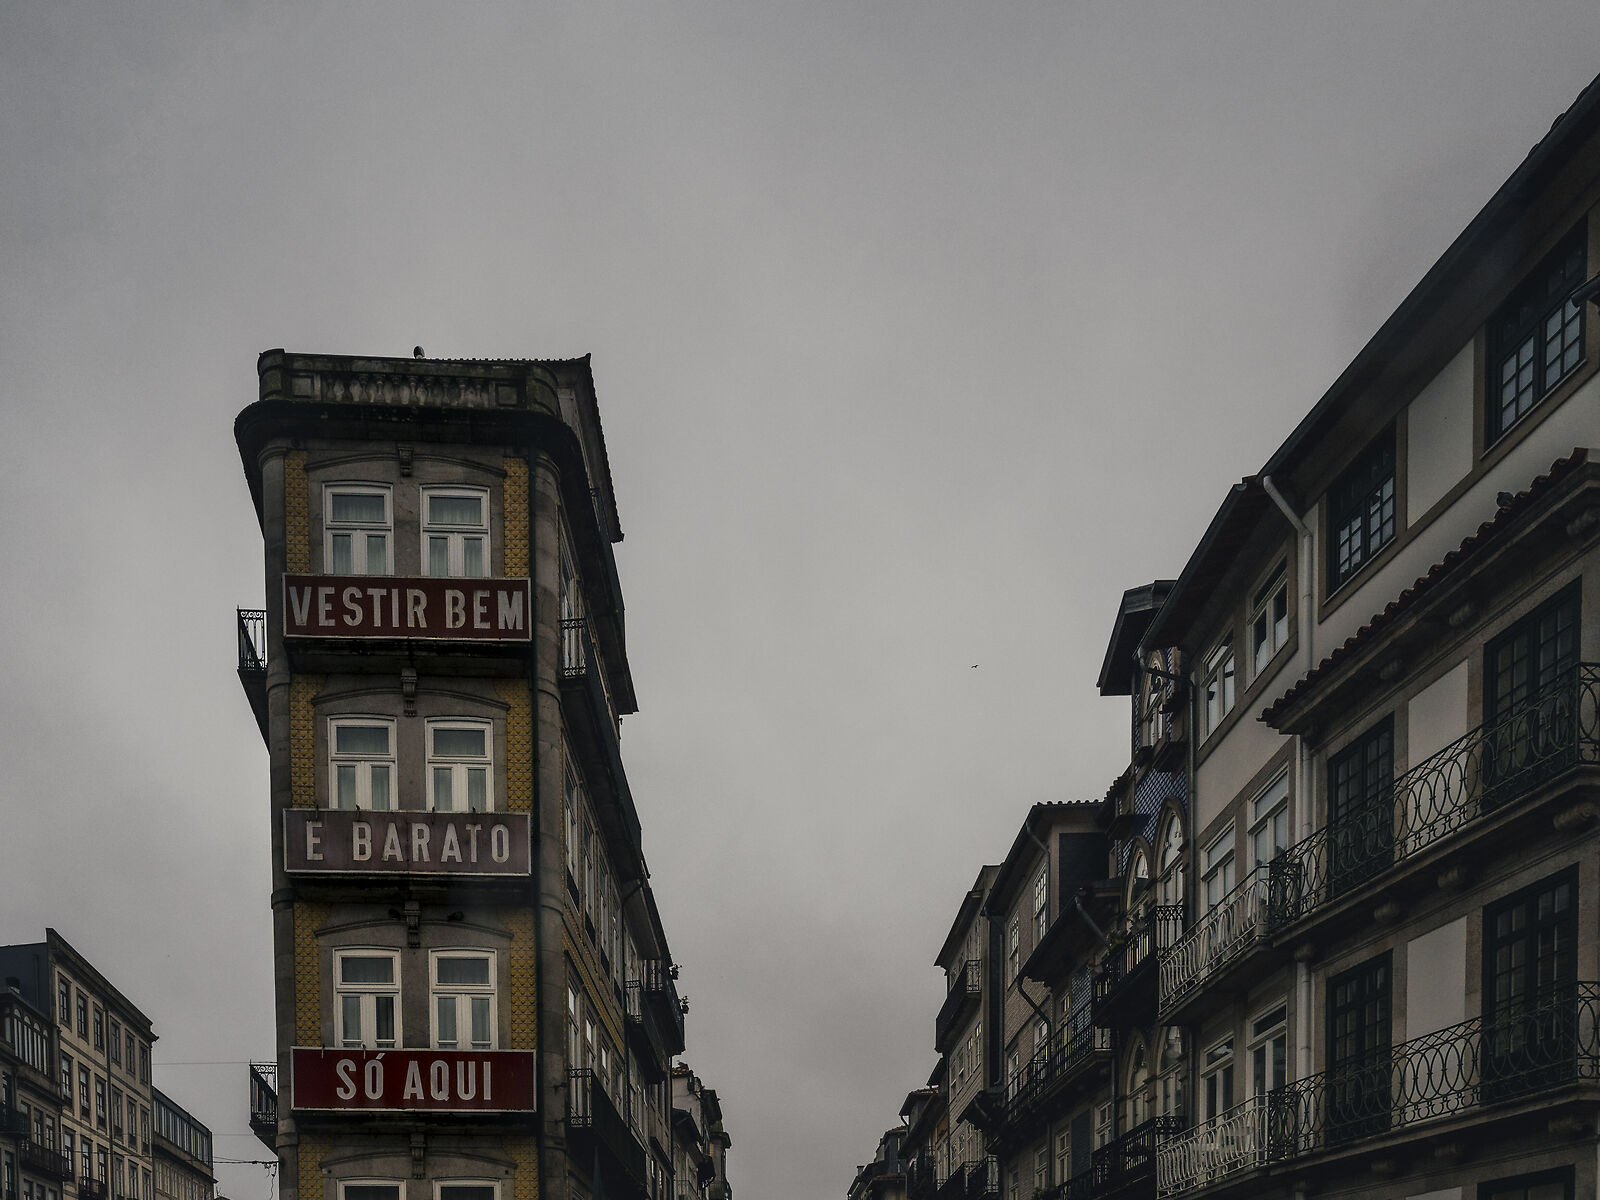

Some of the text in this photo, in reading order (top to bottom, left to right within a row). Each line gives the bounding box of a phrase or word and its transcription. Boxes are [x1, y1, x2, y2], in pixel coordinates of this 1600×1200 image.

[289, 586, 524, 631] VESTIR BEM
[305, 821, 511, 864] E BARATO
[336, 1052, 493, 1102] SÓ AQUI
